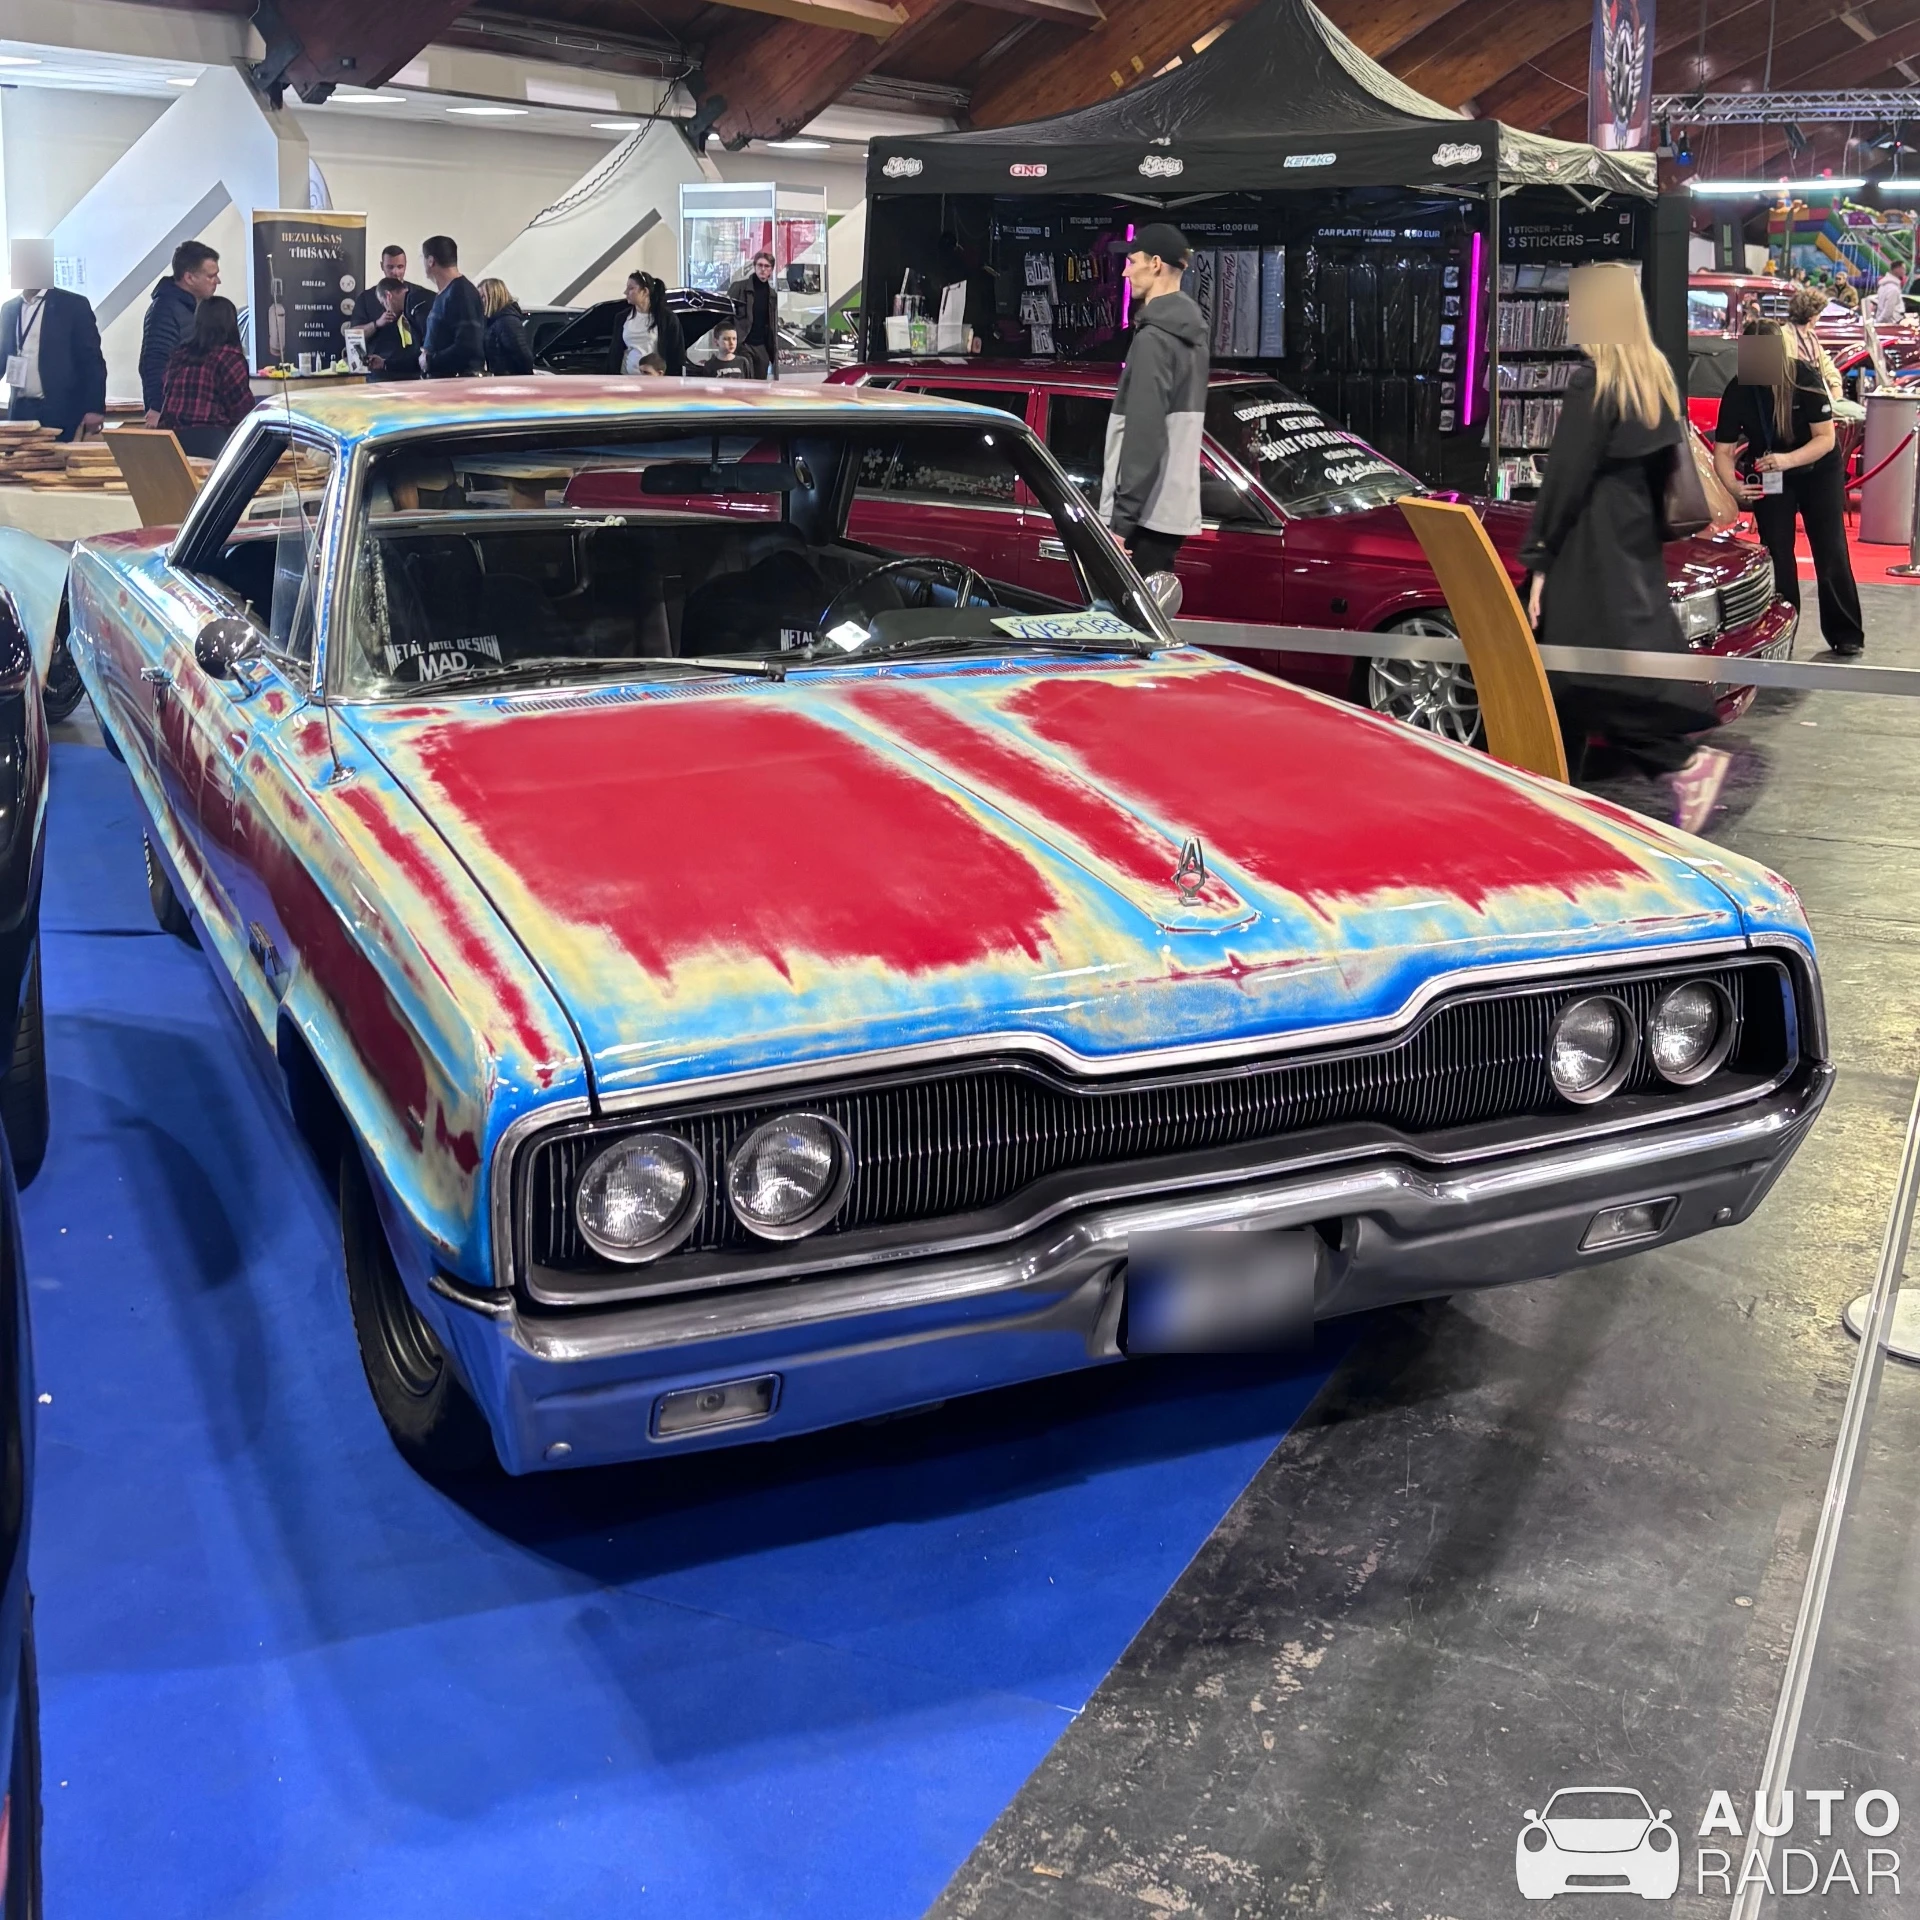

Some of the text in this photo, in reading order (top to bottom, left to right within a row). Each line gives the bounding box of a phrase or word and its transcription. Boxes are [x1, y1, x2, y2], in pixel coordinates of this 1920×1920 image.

[1285, 154, 1336, 167] KETAKO
[1243, 223, 1259, 231] EUR
[1318, 229, 1335, 237] CAR
[1336, 229, 1362, 237] PLATE
[1362, 229, 1396, 238] FRAMES
[1423, 230, 1441, 238] EUR
[1514, 225, 1551, 234] STICKER
[281, 232, 342, 244] BEZMAKSAS
[1508, 237, 1516, 248] 3
[1519, 235, 1584, 248] STICKERS
[1603, 232, 1621, 245] 5€
[1276, 416, 1325, 431] KETAKO
[1260, 437, 1301, 461] BUILT
[1294, 433, 1326, 449] FOR
[781, 629, 815, 652] METAL
[428, 640, 455, 652] ARTEL
[457, 635, 503, 664] DESIGN
[418, 652, 468, 682] MAD
